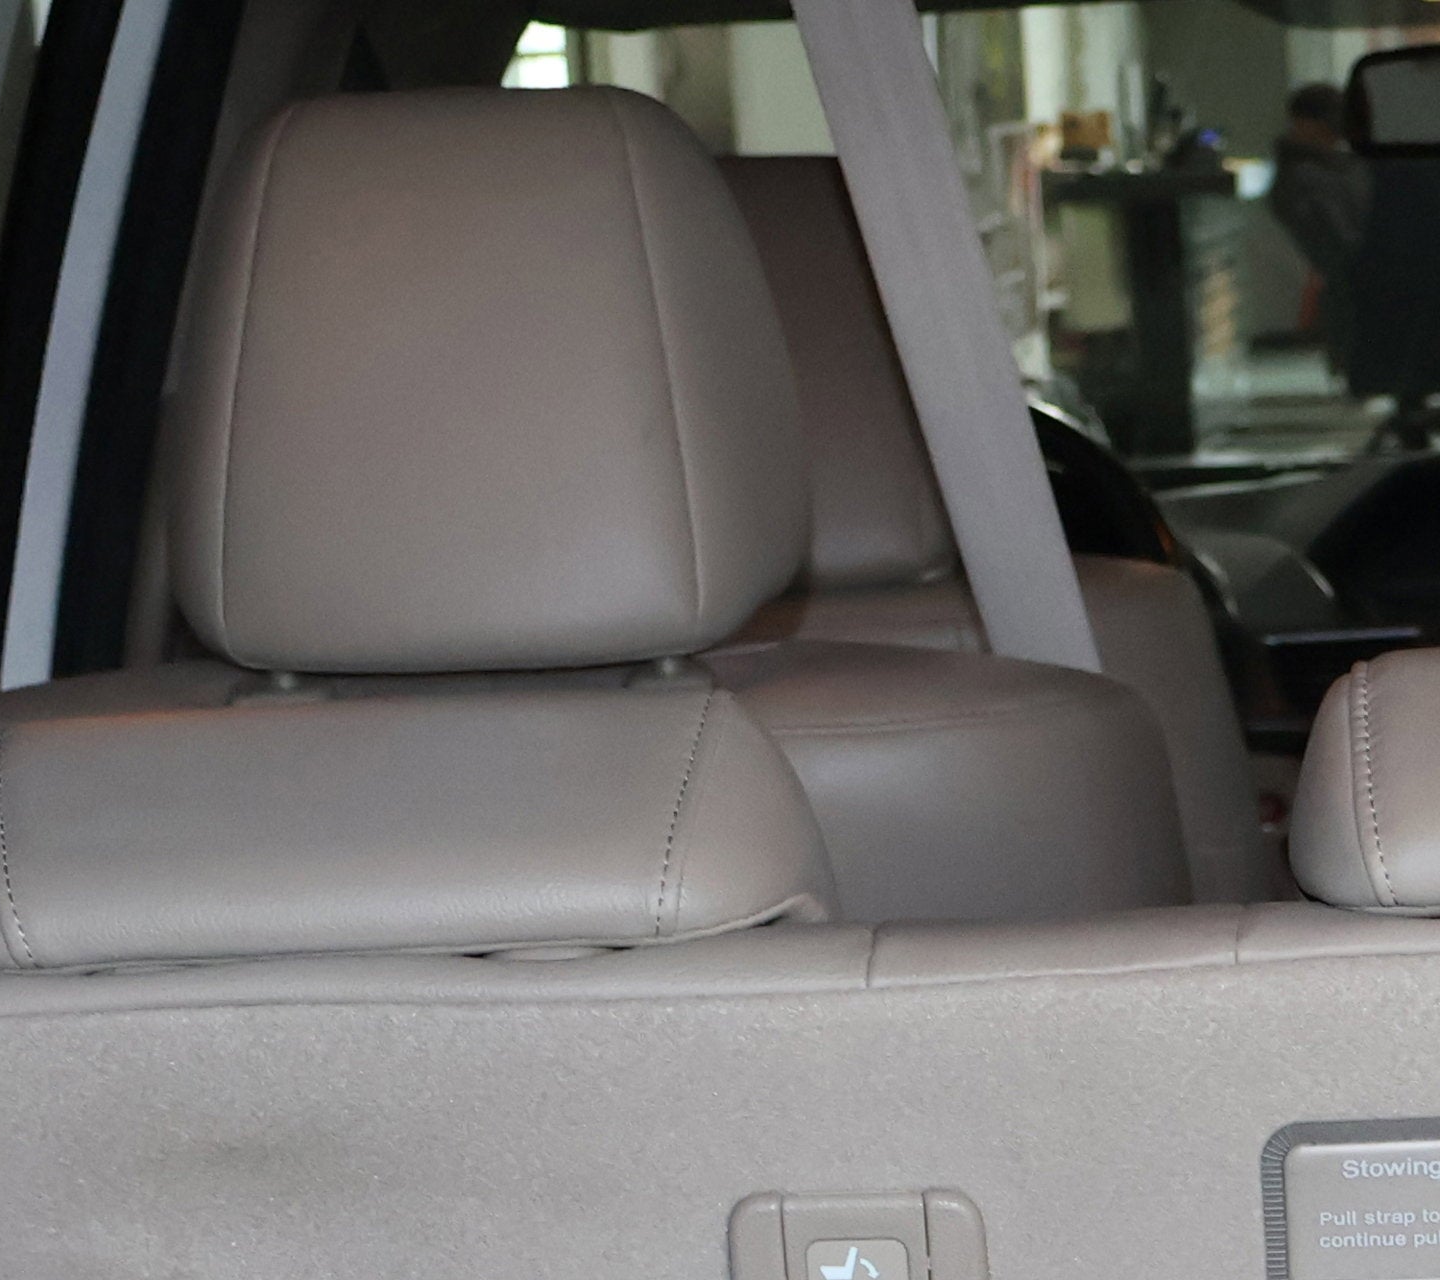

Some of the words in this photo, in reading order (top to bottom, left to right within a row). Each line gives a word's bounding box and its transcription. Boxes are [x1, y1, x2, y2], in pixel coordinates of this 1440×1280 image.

[1320, 1210, 1357, 1226] Pull
[1364, 1210, 1415, 1227] strap
[1422, 1208, 1440, 1223] to
[1319, 1232, 1407, 1248] continue
